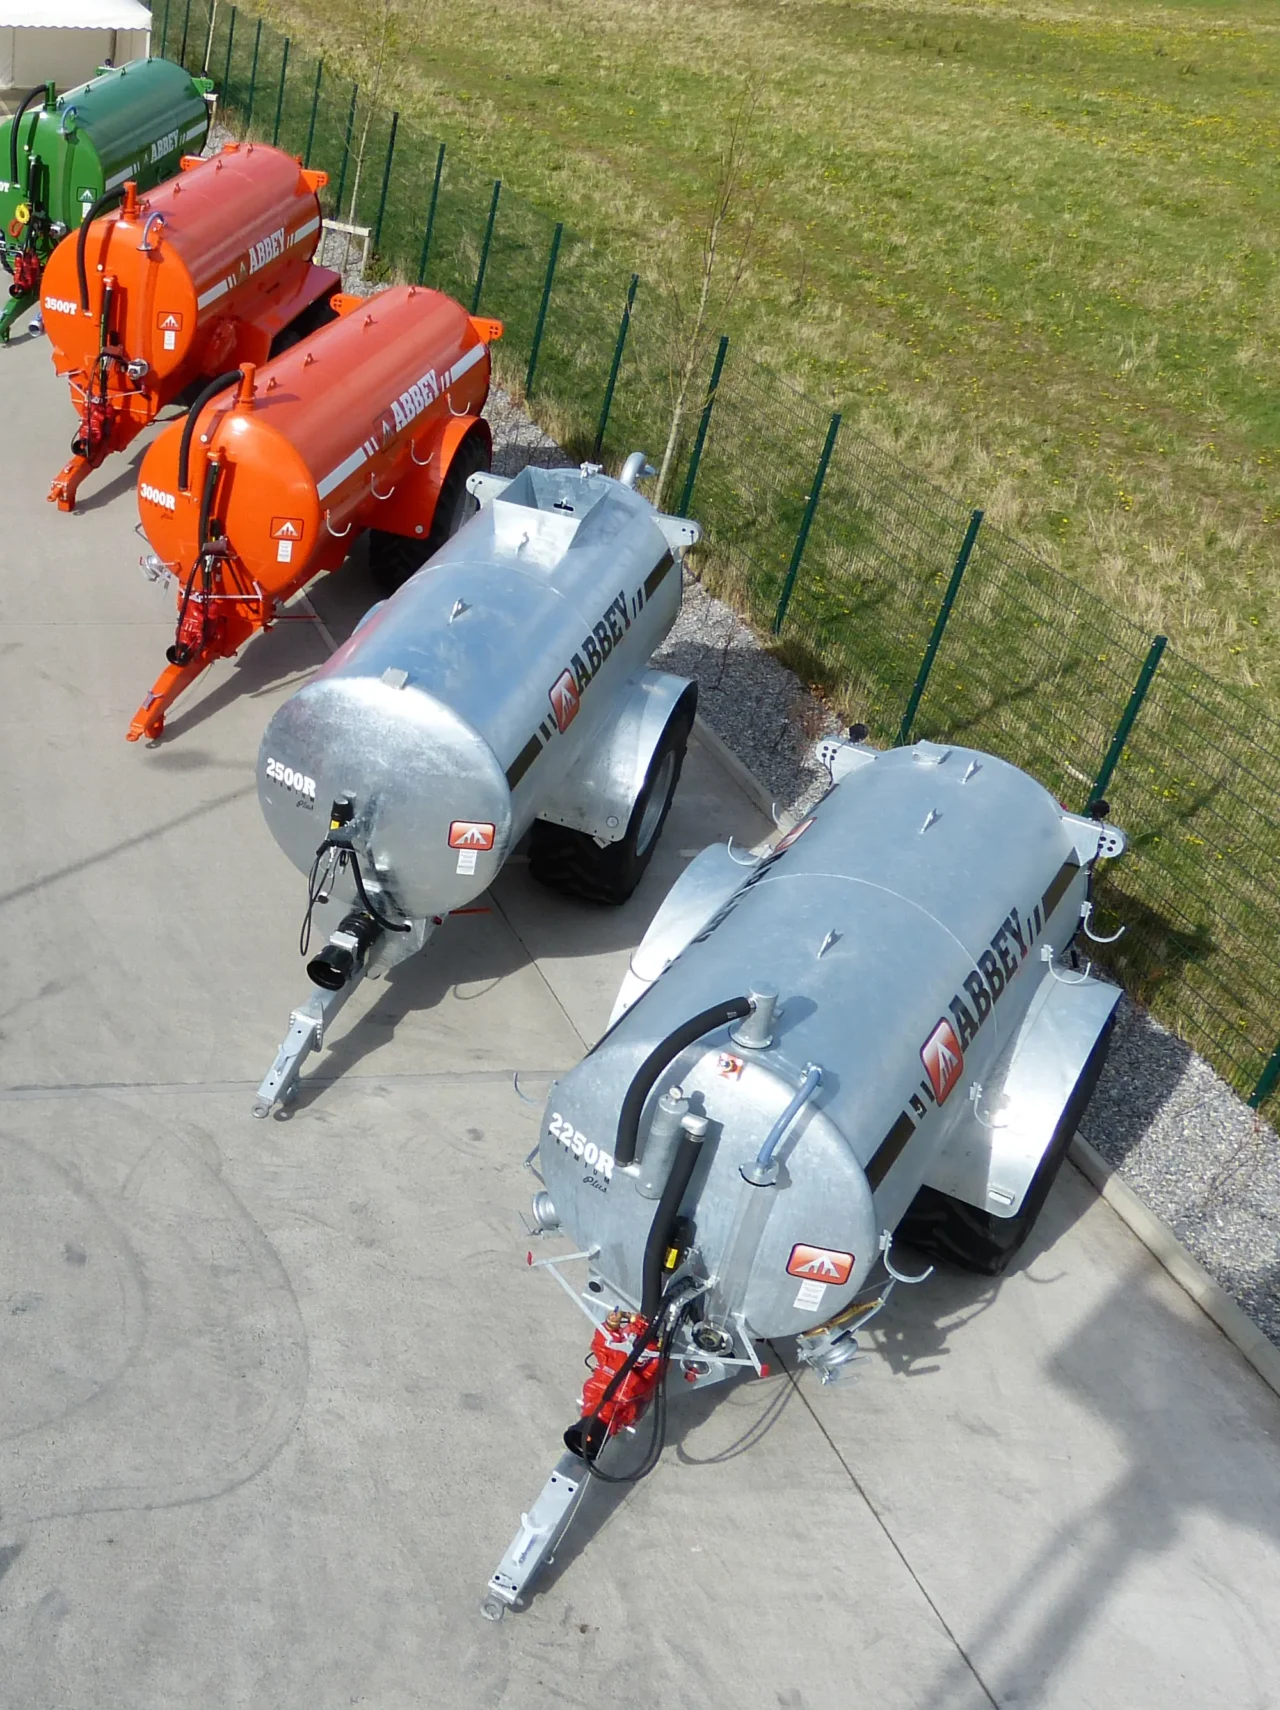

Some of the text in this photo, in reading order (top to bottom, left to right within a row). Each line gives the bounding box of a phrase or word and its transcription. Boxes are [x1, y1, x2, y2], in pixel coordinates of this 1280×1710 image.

[150, 129, 180, 164] ABBEY
[249, 227, 286, 275] ABBEY
[44, 296, 77, 315] 3500T
[390, 369, 440, 432] ABBEY
[140, 483, 176, 511] 3000R
[570, 590, 631, 697] ABBEY
[266, 757, 316, 798] 2500R
[948, 906, 1028, 1054] ABBEY
[548, 1112, 615, 1180] 2250R
[582, 1176, 608, 1193] Plus
